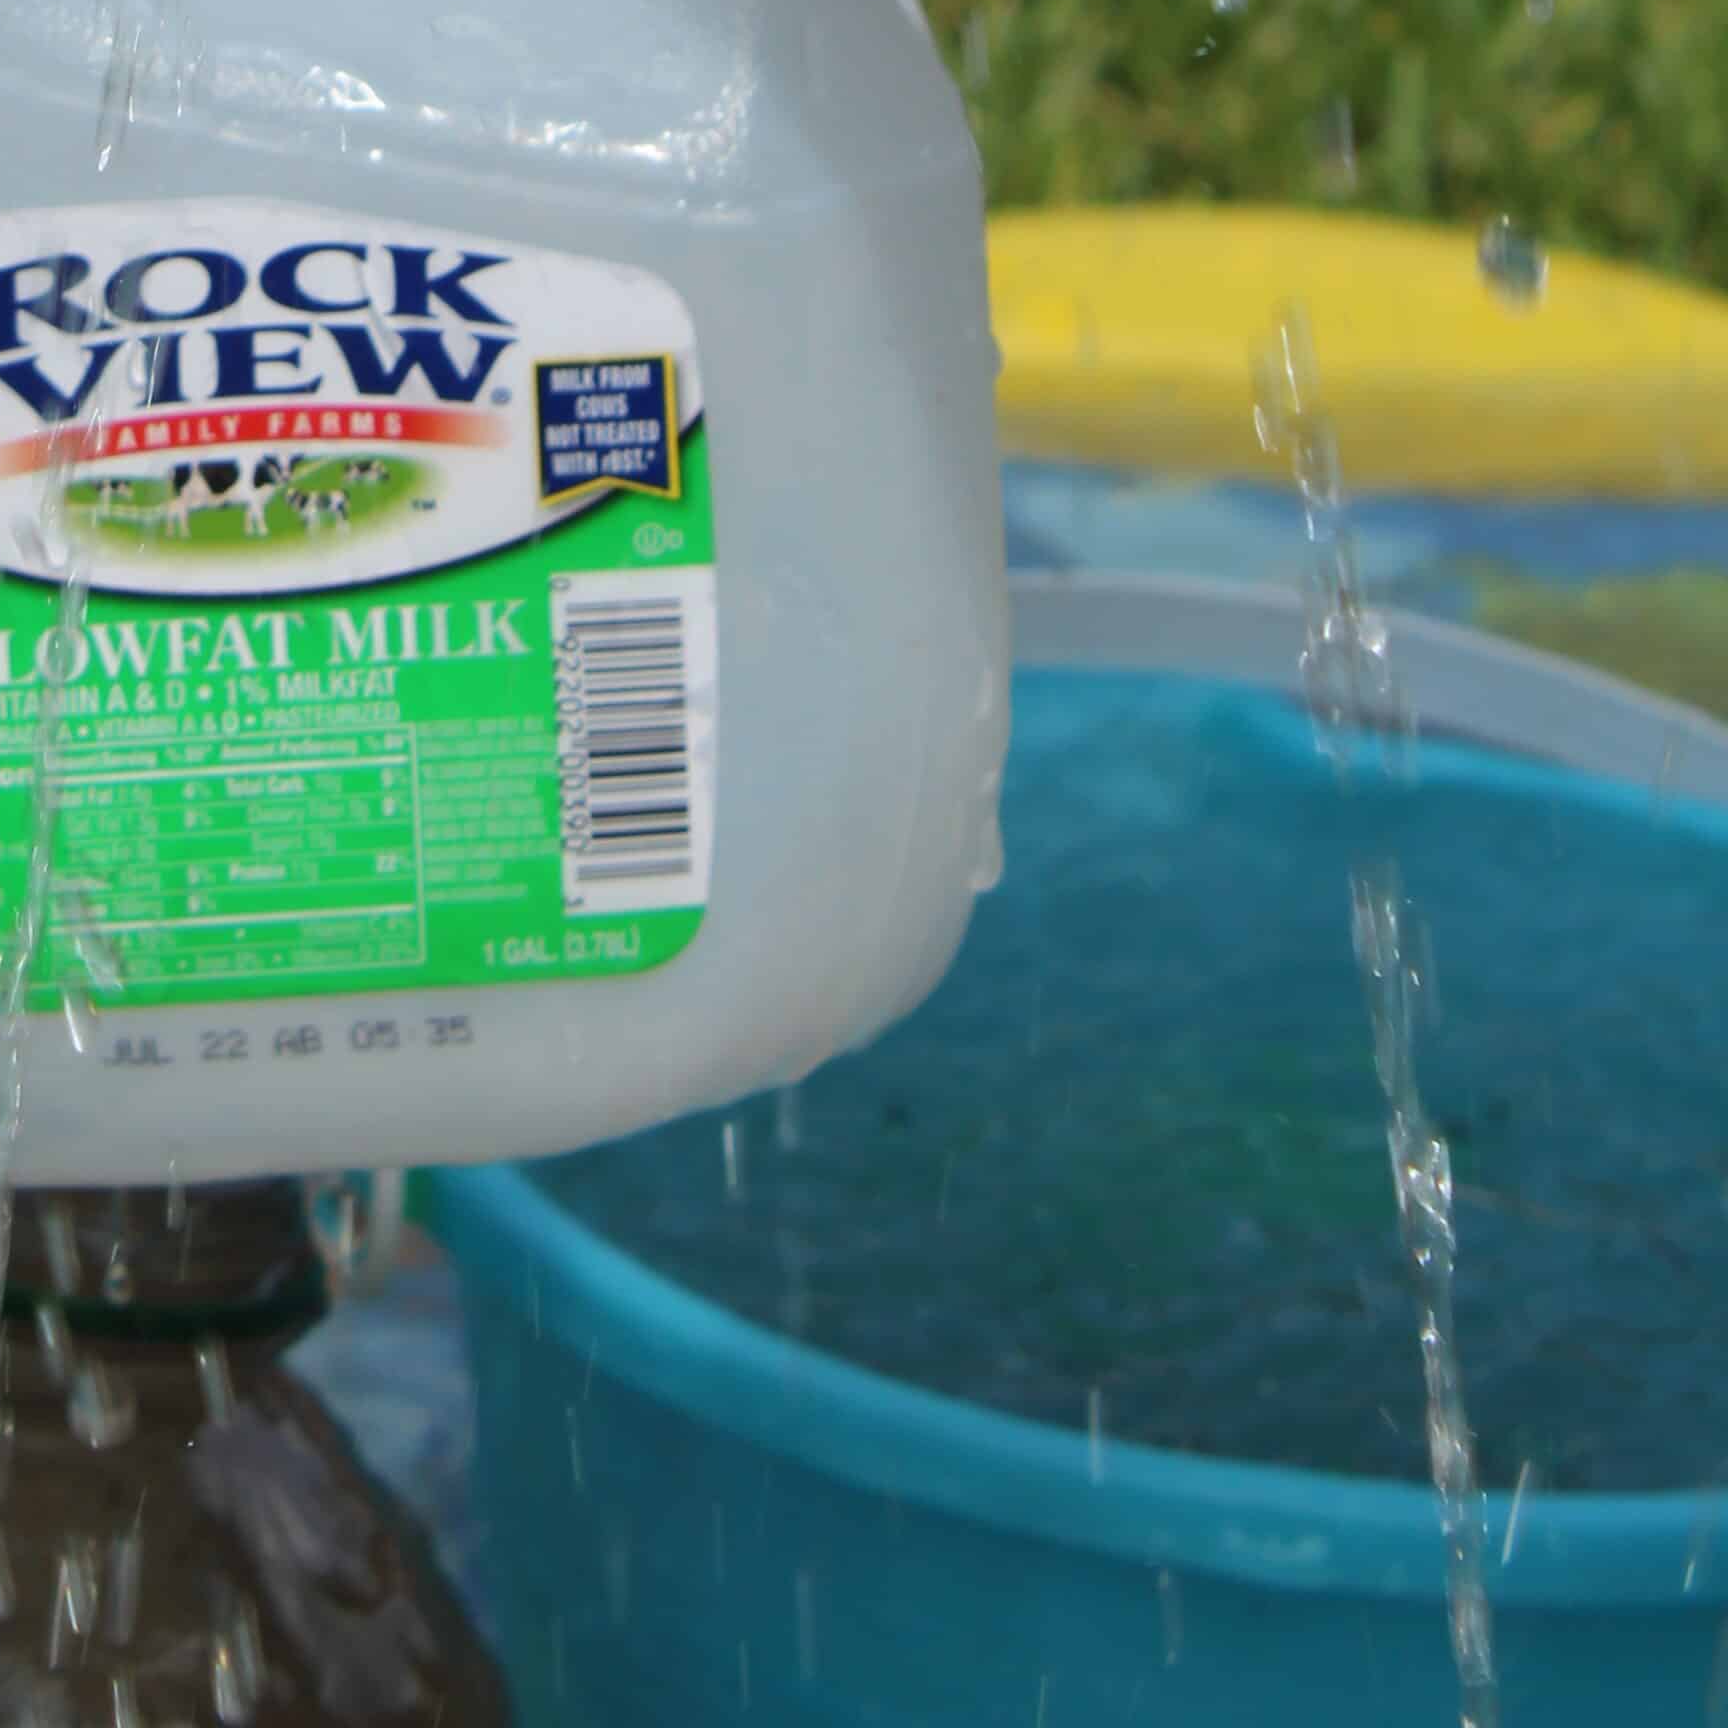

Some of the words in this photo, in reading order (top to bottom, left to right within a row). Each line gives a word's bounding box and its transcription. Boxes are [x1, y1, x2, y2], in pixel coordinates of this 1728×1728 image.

[550, 367, 594, 392] MILK
[598, 364, 651, 389] FROM
[575, 393, 628, 419] COWS
[102, 410, 241, 450] AMILY
[268, 410, 403, 438] FARMS
[544, 423, 580, 447] NOT
[584, 419, 660, 445] TREATED
[551, 451, 597, 476] WITH
[325, 599, 531, 665] MILK
[107, 684, 127, 711] A
[135, 684, 156, 710] &
[165, 680, 186, 708] D
[223, 674, 269, 704] 1%
[277, 666, 399, 700] MILKFAT
[262, 701, 400, 728] PASTEURIZED
[482, 941, 494, 967] 1
[101, 1034, 174, 1070] JUL
[200, 1027, 249, 1061] 22
